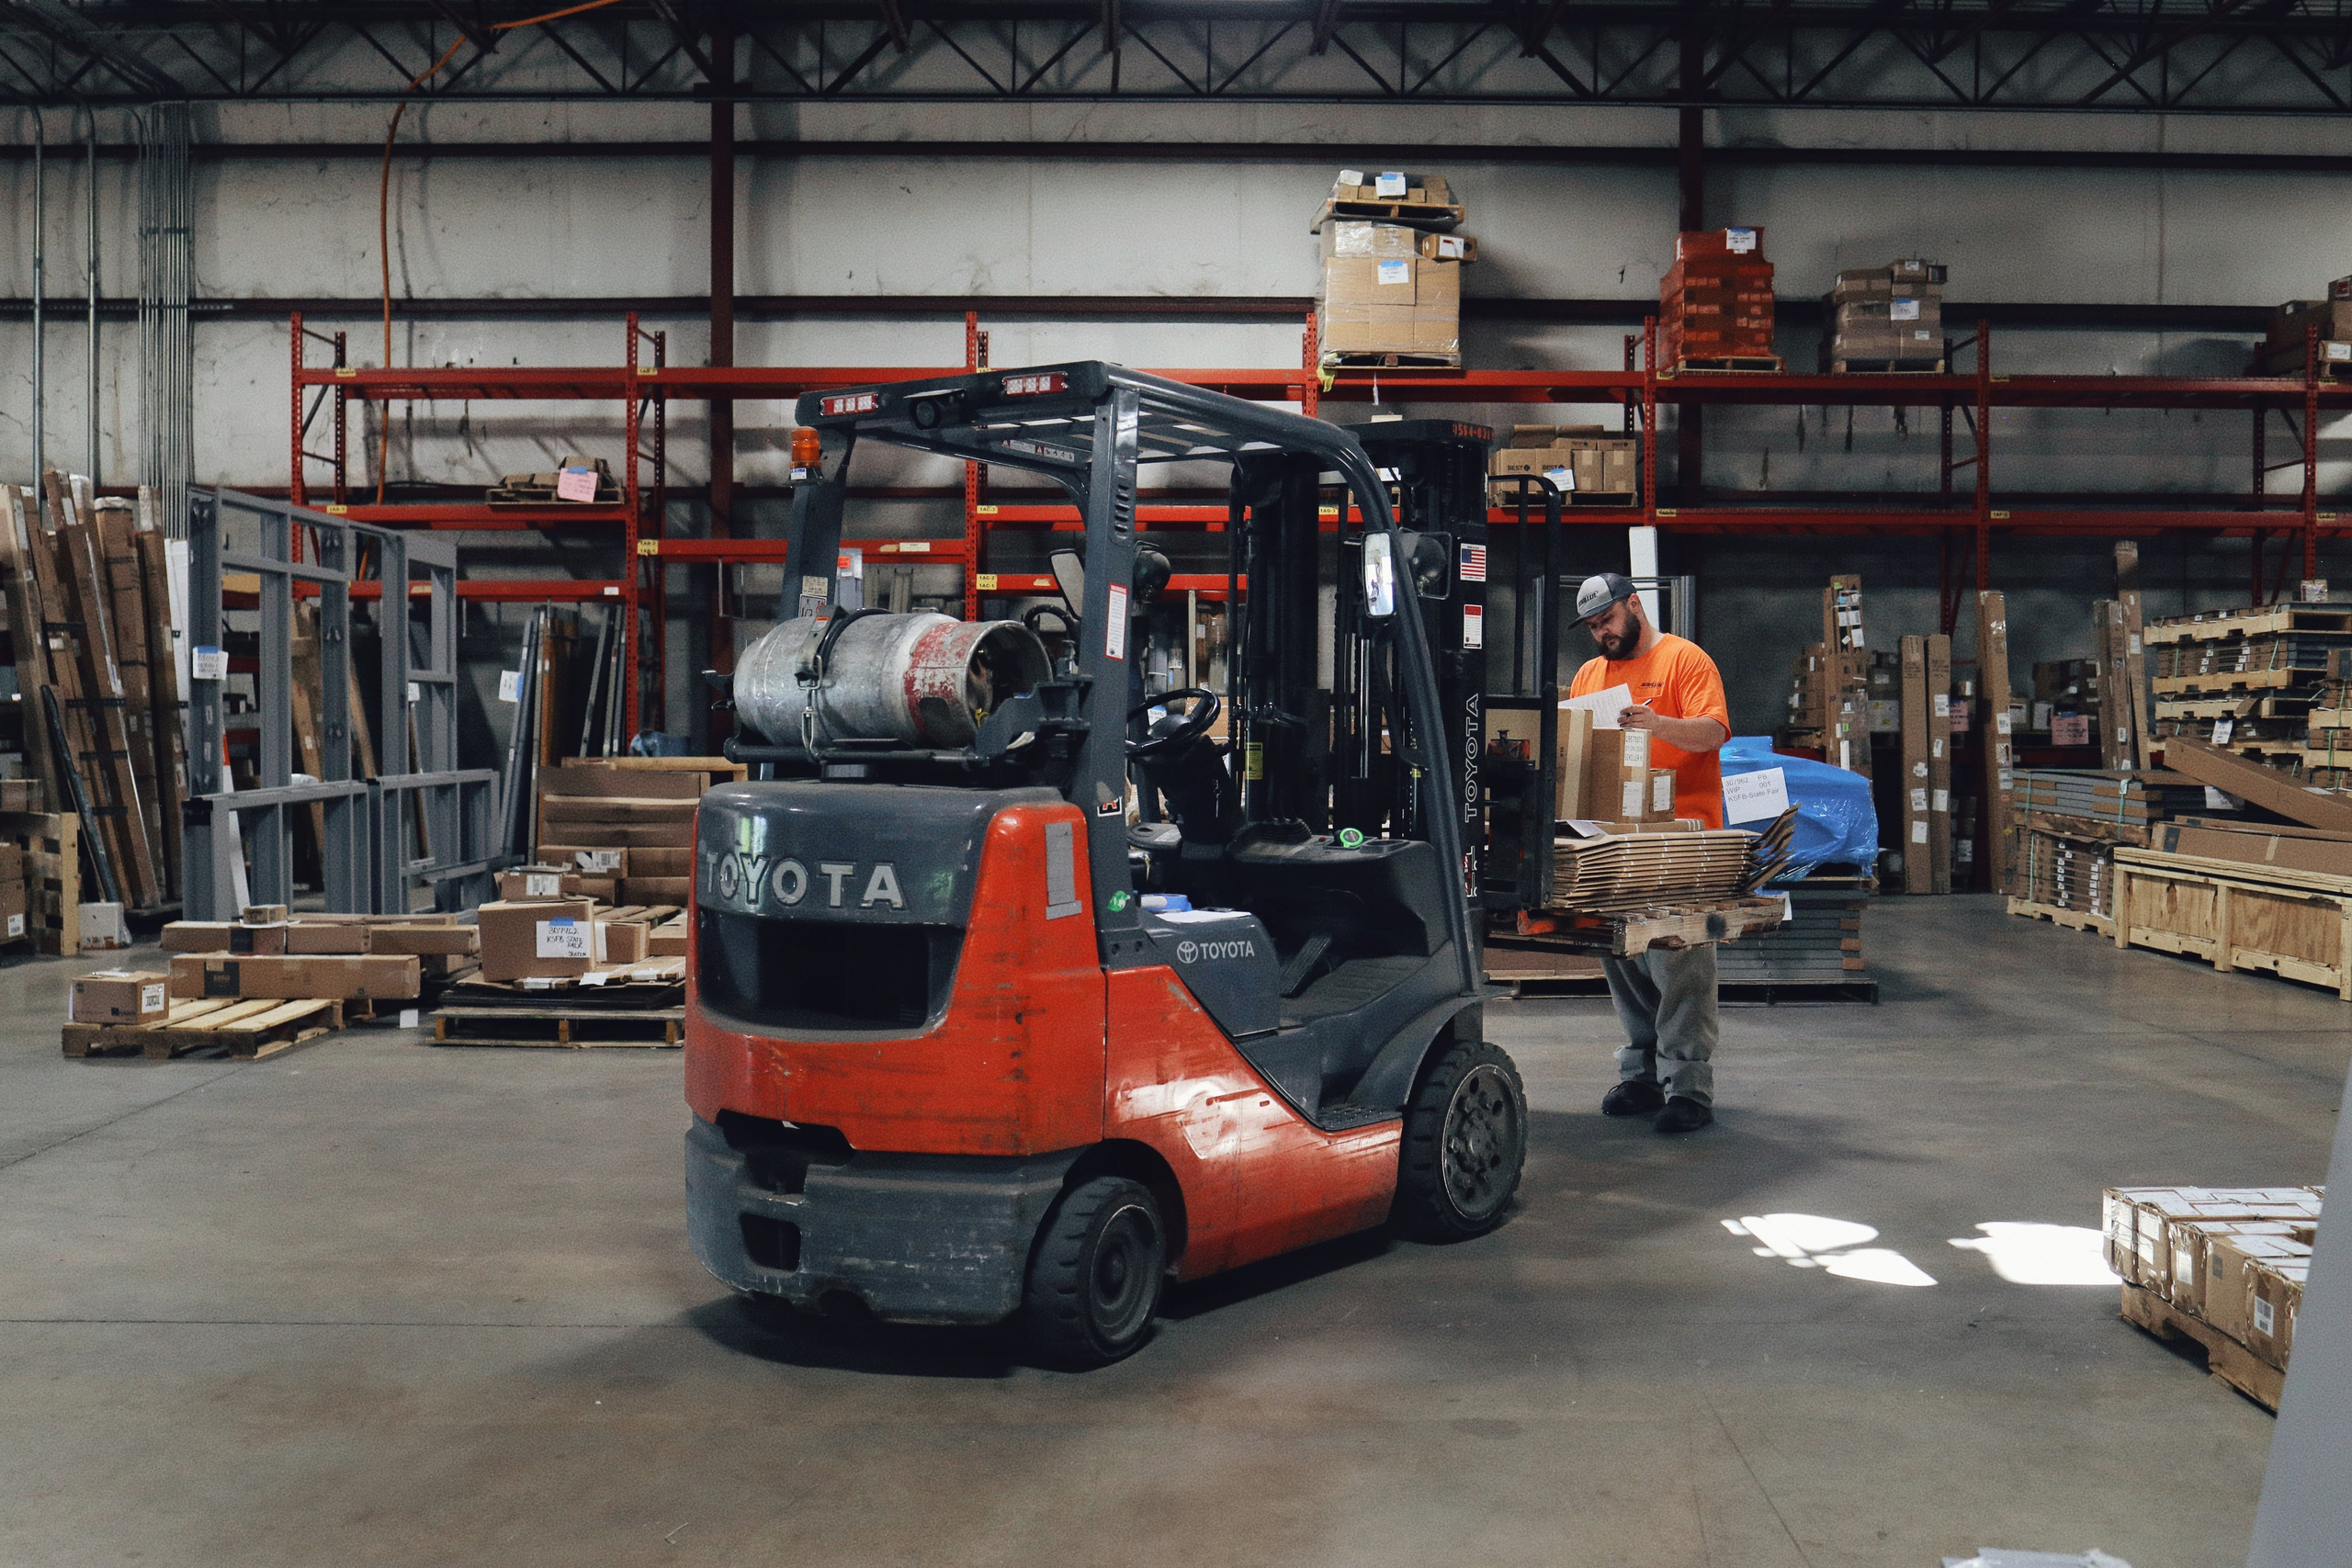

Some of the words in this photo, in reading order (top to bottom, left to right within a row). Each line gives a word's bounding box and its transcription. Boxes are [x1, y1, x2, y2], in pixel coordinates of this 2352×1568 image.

[1465, 694, 1478, 822] TOYOTA
[1725, 777, 1749, 787] 307962
[1727, 792, 1766, 802] KSFB-State
[707, 852, 904, 908] TOYOTA
[1200, 941, 1255, 960] TOYOTA
